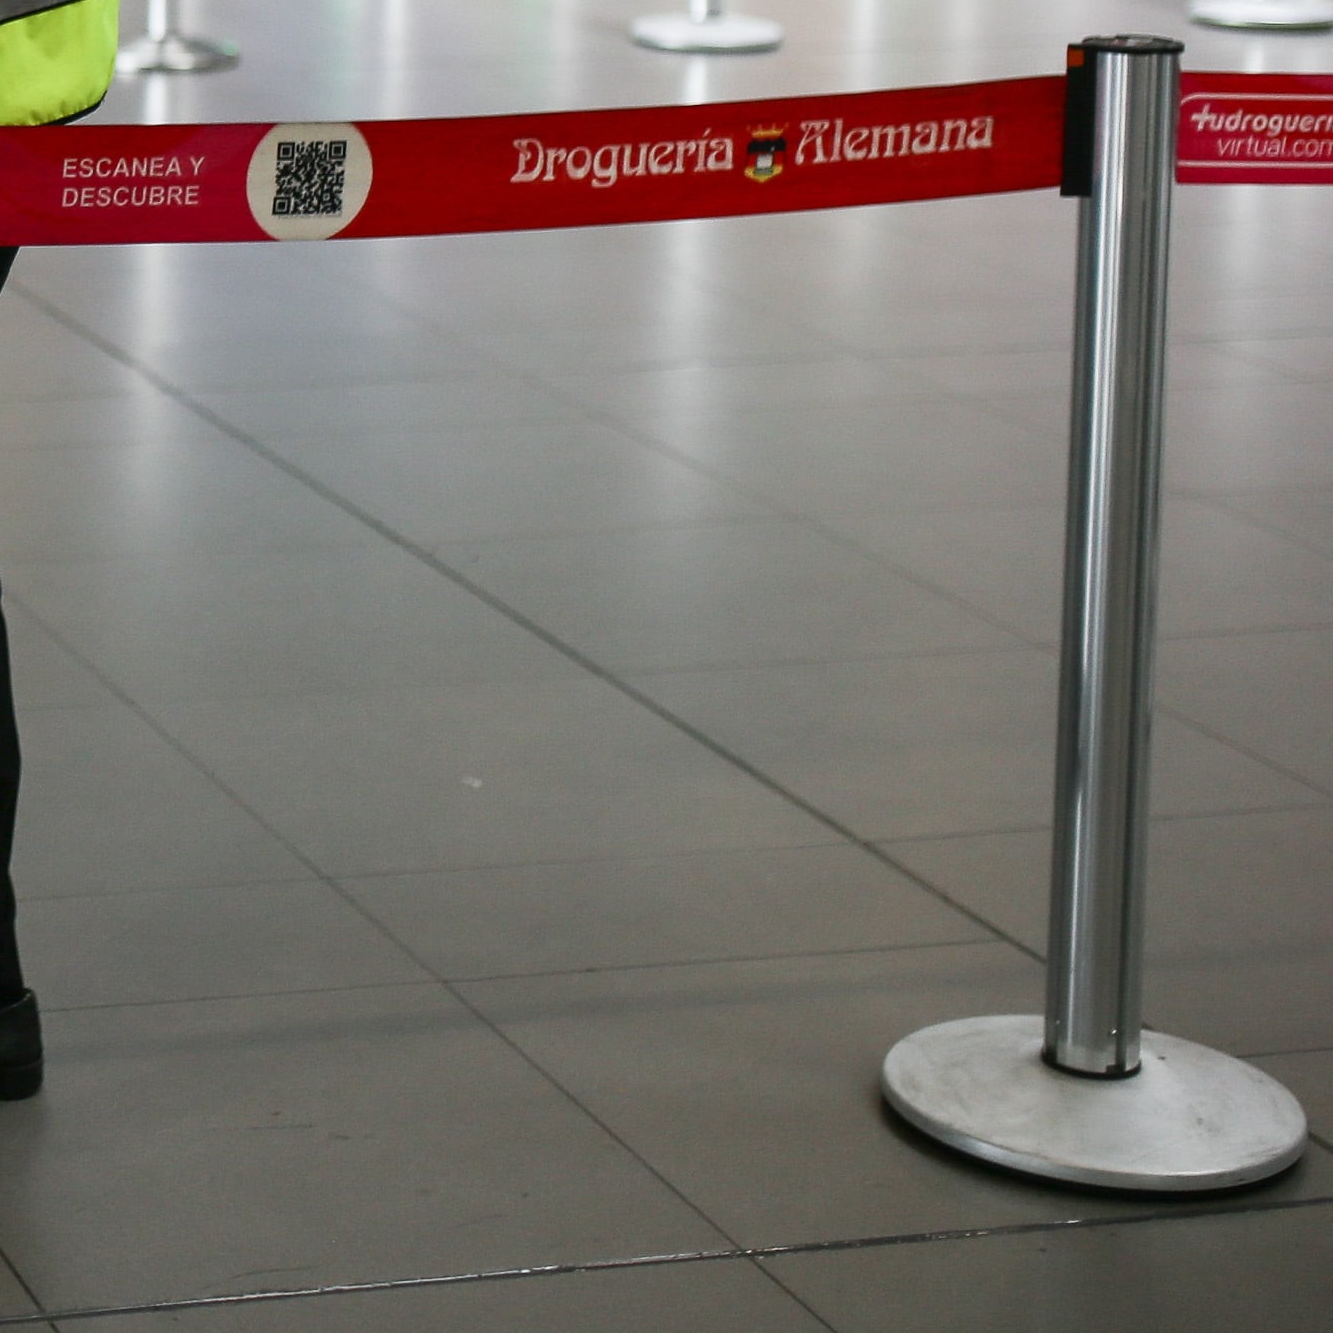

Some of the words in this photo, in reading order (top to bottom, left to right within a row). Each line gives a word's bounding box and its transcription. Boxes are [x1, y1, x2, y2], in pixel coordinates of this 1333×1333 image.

[1191, 104, 1333, 137] tudrogueri
[510, 127, 734, 188] Droguería
[796, 114, 994, 168] Alemana
[62, 157, 181, 180] ESCANEA
[190, 156, 205, 175] Y
[61, 185, 200, 208] DESCUBRE
